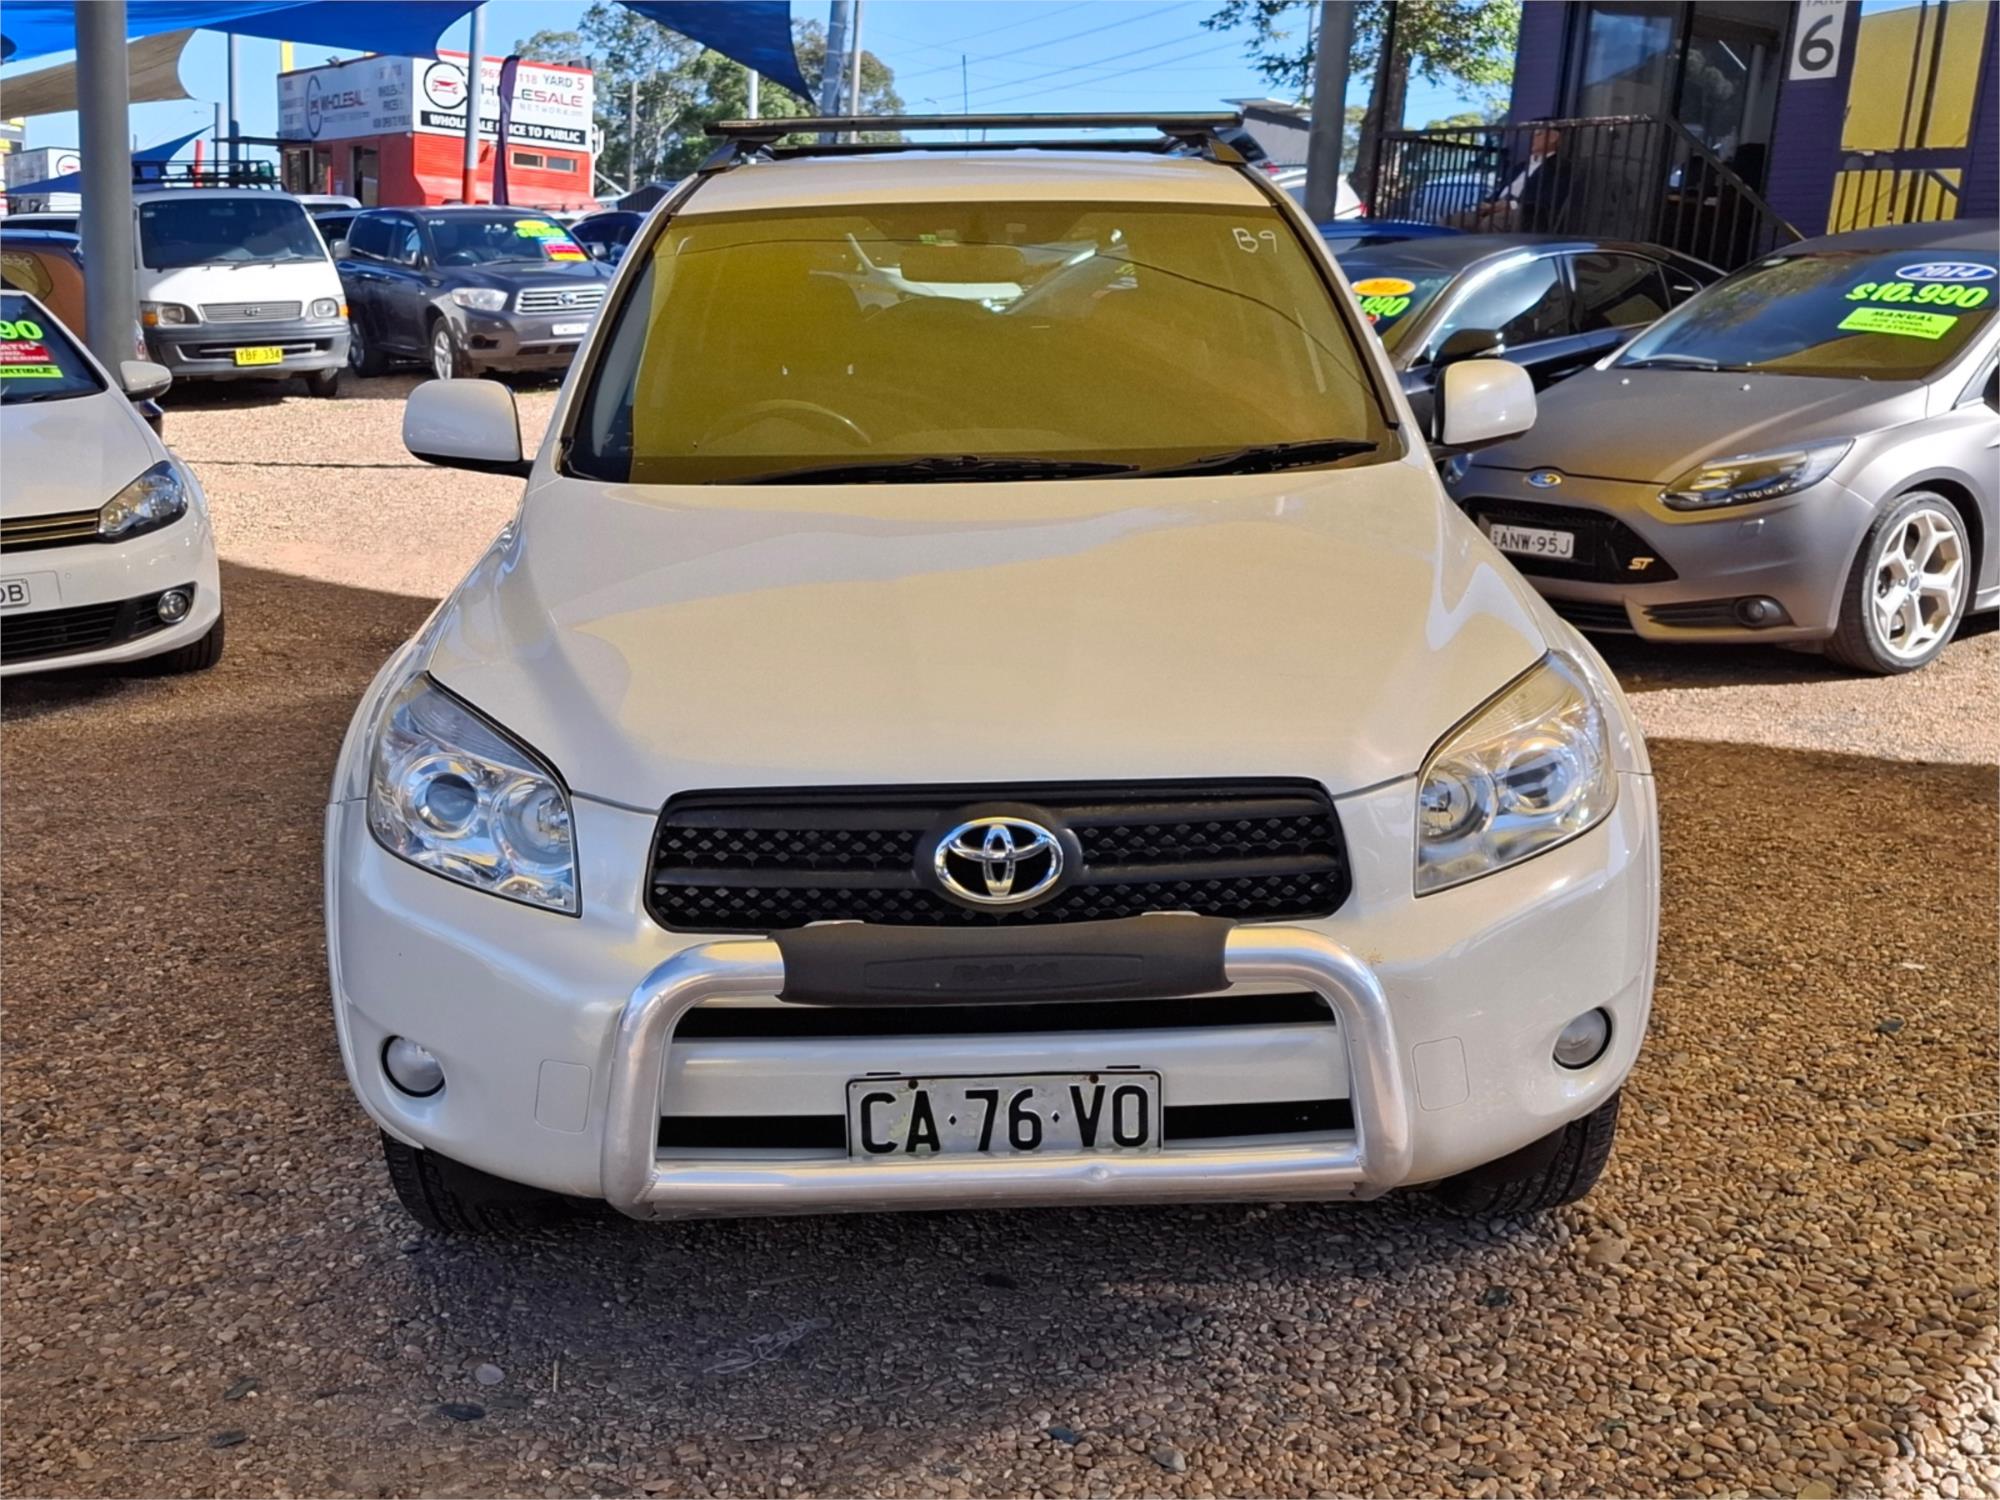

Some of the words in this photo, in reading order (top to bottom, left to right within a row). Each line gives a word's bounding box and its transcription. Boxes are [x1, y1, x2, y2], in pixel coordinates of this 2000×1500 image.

[1799, 14, 1834, 71] 6
[543, 74, 573, 89] YARD
[576, 77, 585, 91] 5
[528, 125, 543, 139] TO
[544, 128, 581, 143] PUBLIC
[1911, 266, 1981, 278] 2014
[1870, 311, 1933, 322] MANUAL
